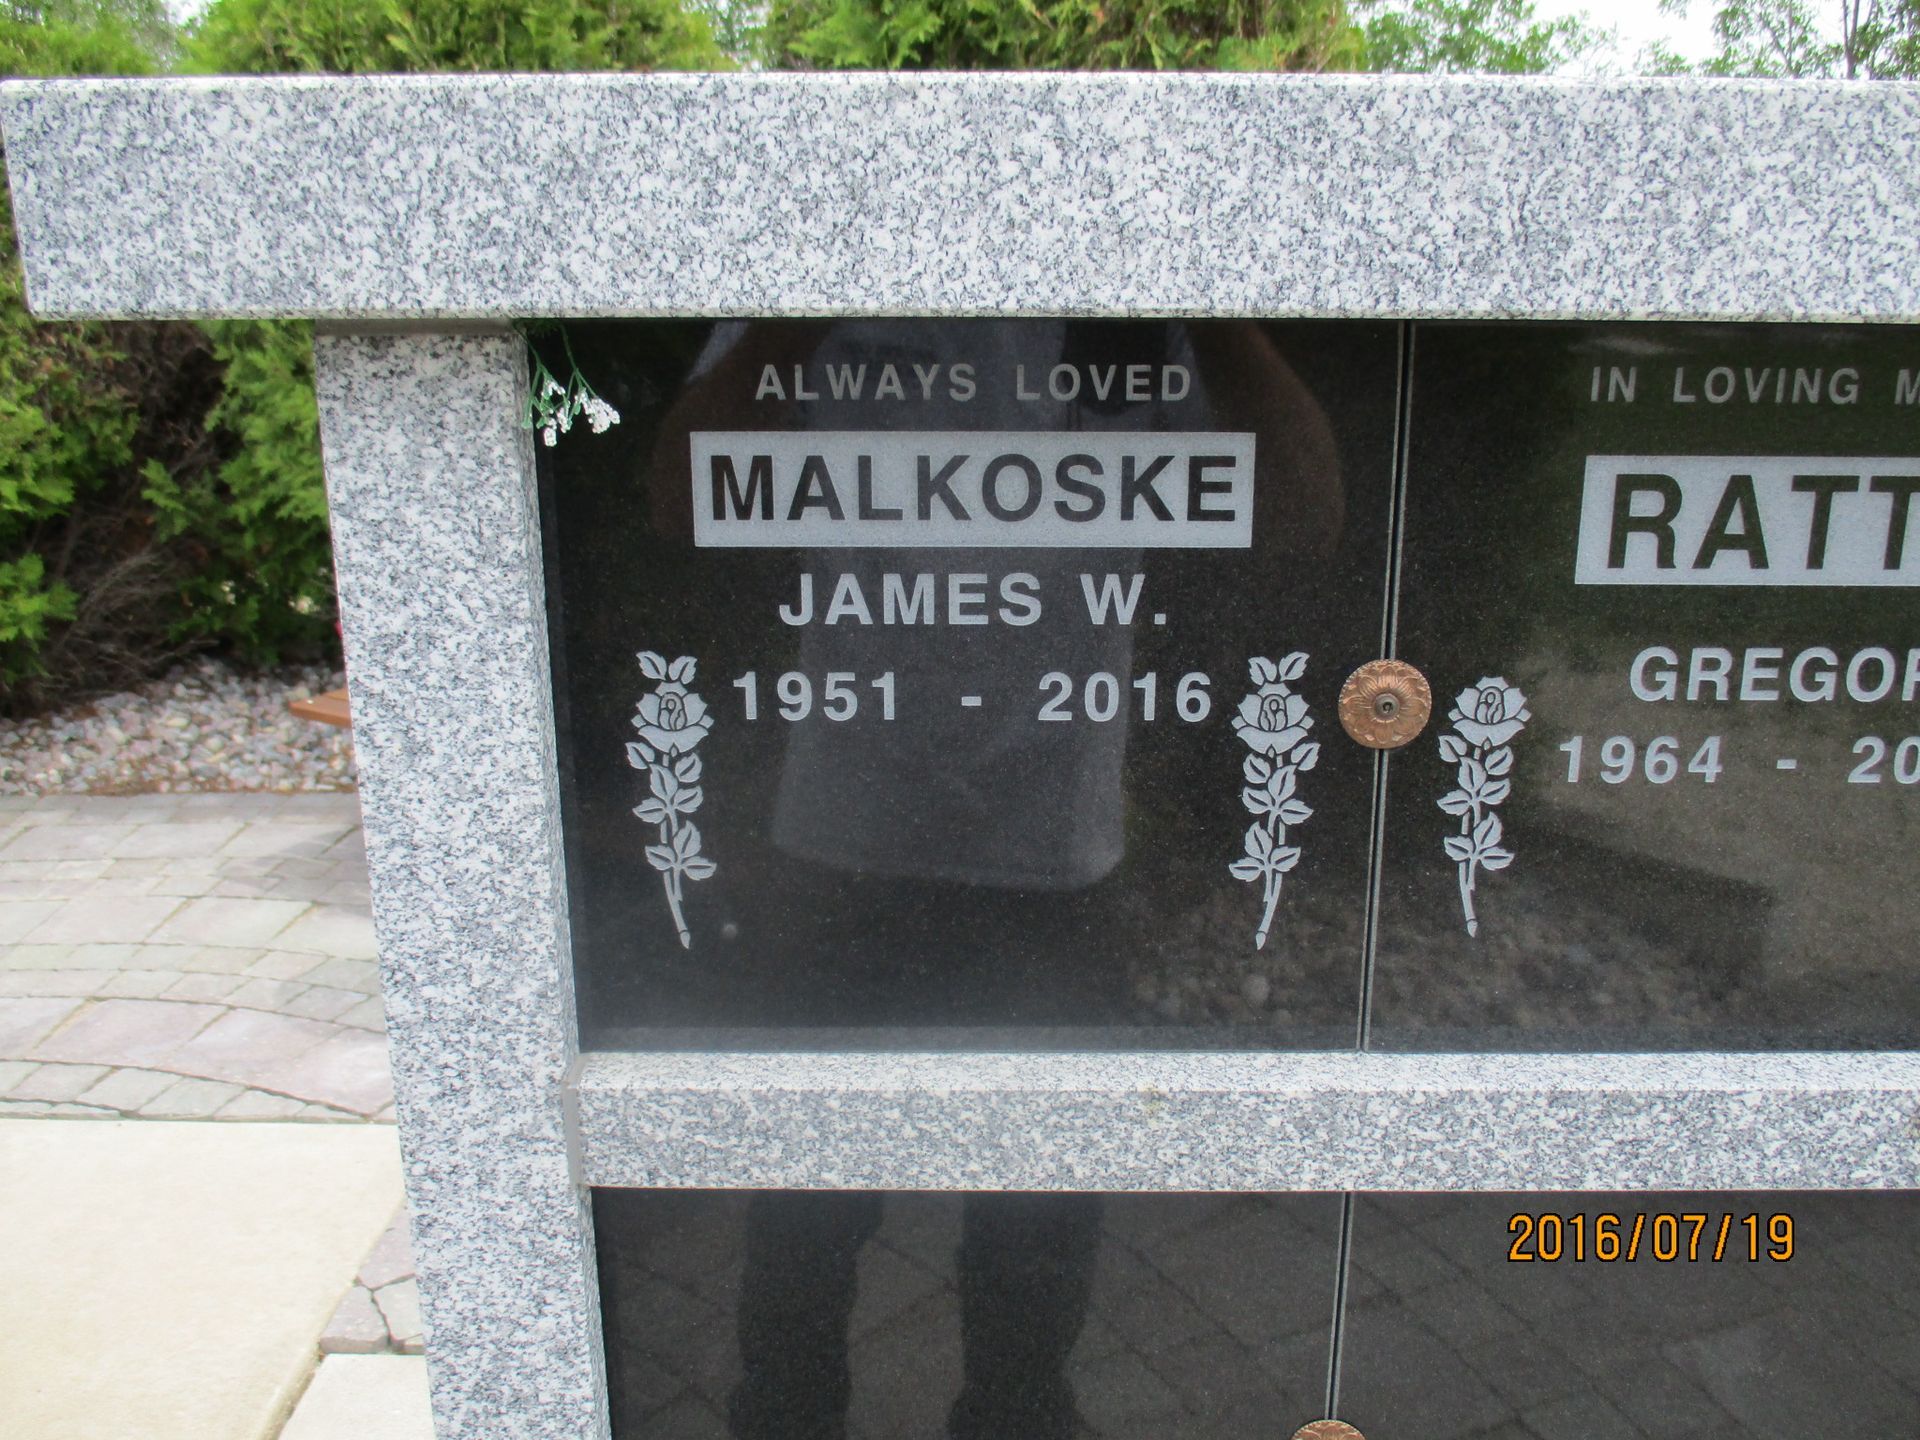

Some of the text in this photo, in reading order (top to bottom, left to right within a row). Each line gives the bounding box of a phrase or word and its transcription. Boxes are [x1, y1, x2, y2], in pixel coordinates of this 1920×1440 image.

[755, 363, 1192, 401] ALWAYS LOVED
[1590, 366, 1638, 403] IN
[1673, 366, 1860, 404] LOVING
[709, 454, 1237, 522] MALKOSKE
[1607, 474, 1920, 570] RATT
[779, 573, 1168, 626] JAMES W.
[733, 671, 1212, 722] 1951 - 2016
[1559, 735, 1920, 785] 1964 - 20
